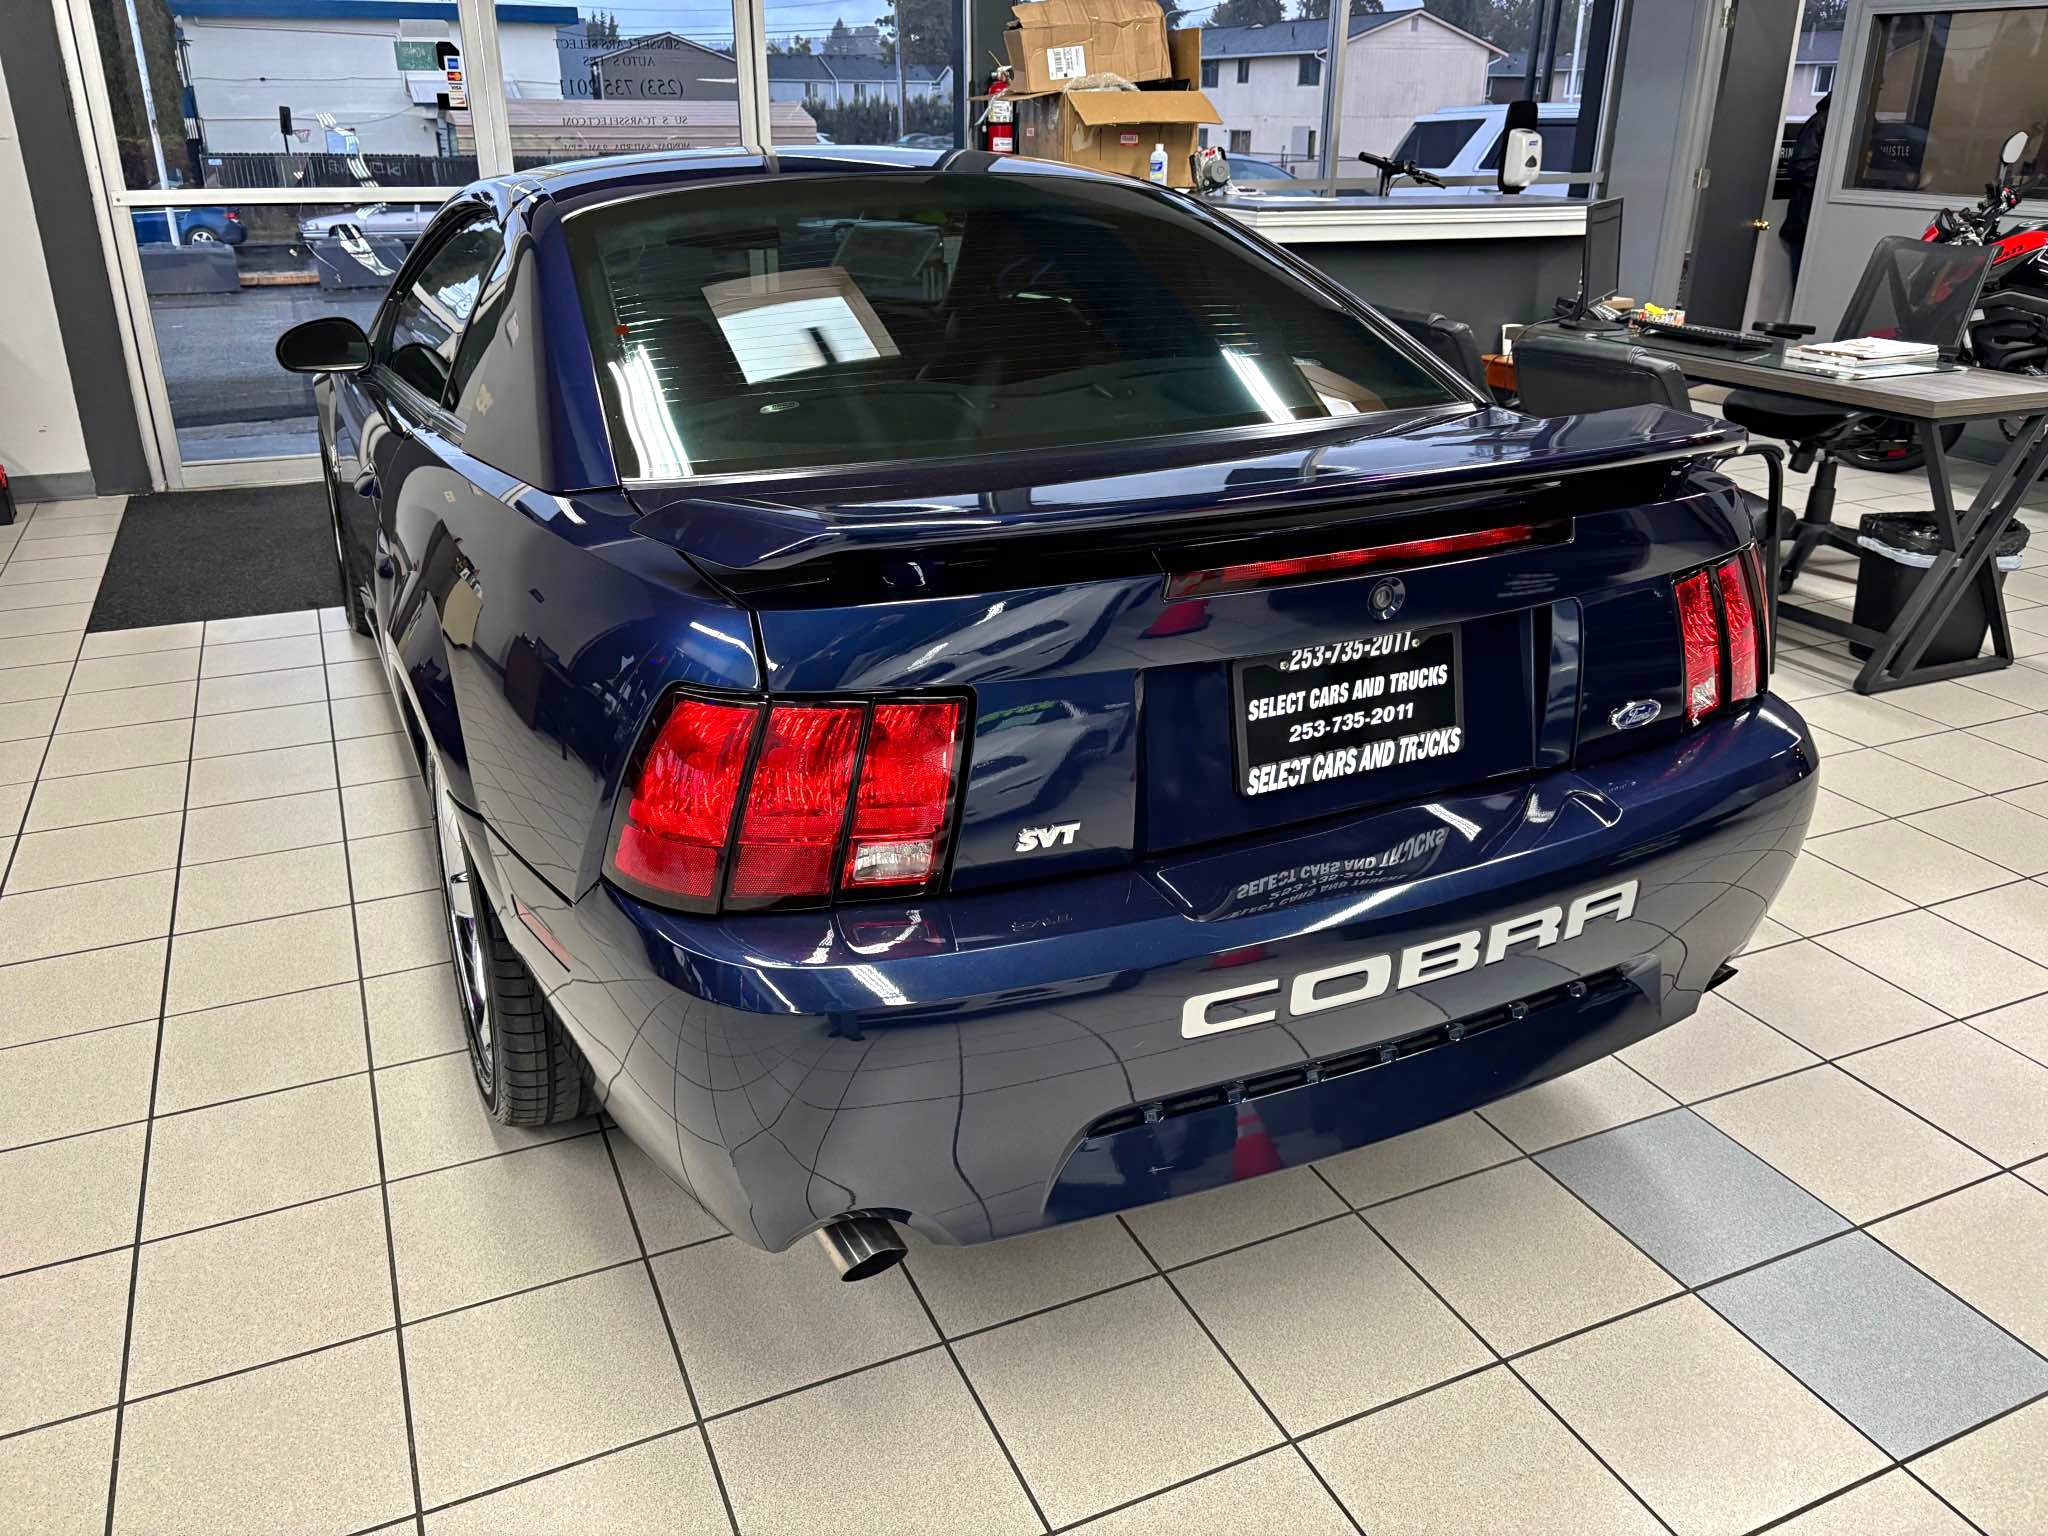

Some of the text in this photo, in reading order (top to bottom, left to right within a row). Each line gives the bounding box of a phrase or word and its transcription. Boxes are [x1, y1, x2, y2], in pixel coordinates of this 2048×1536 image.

[1288, 631, 1412, 671] 253-735-2011
[1248, 664, 1448, 722] SELECT CARS AND TRUCKS
[1288, 702, 1415, 743] 253-735-2011
[1246, 727, 1462, 796] SELECT CARS AND TRUCKS
[1015, 822, 1081, 852] SVT
[1182, 880, 1639, 1040] COBRA
